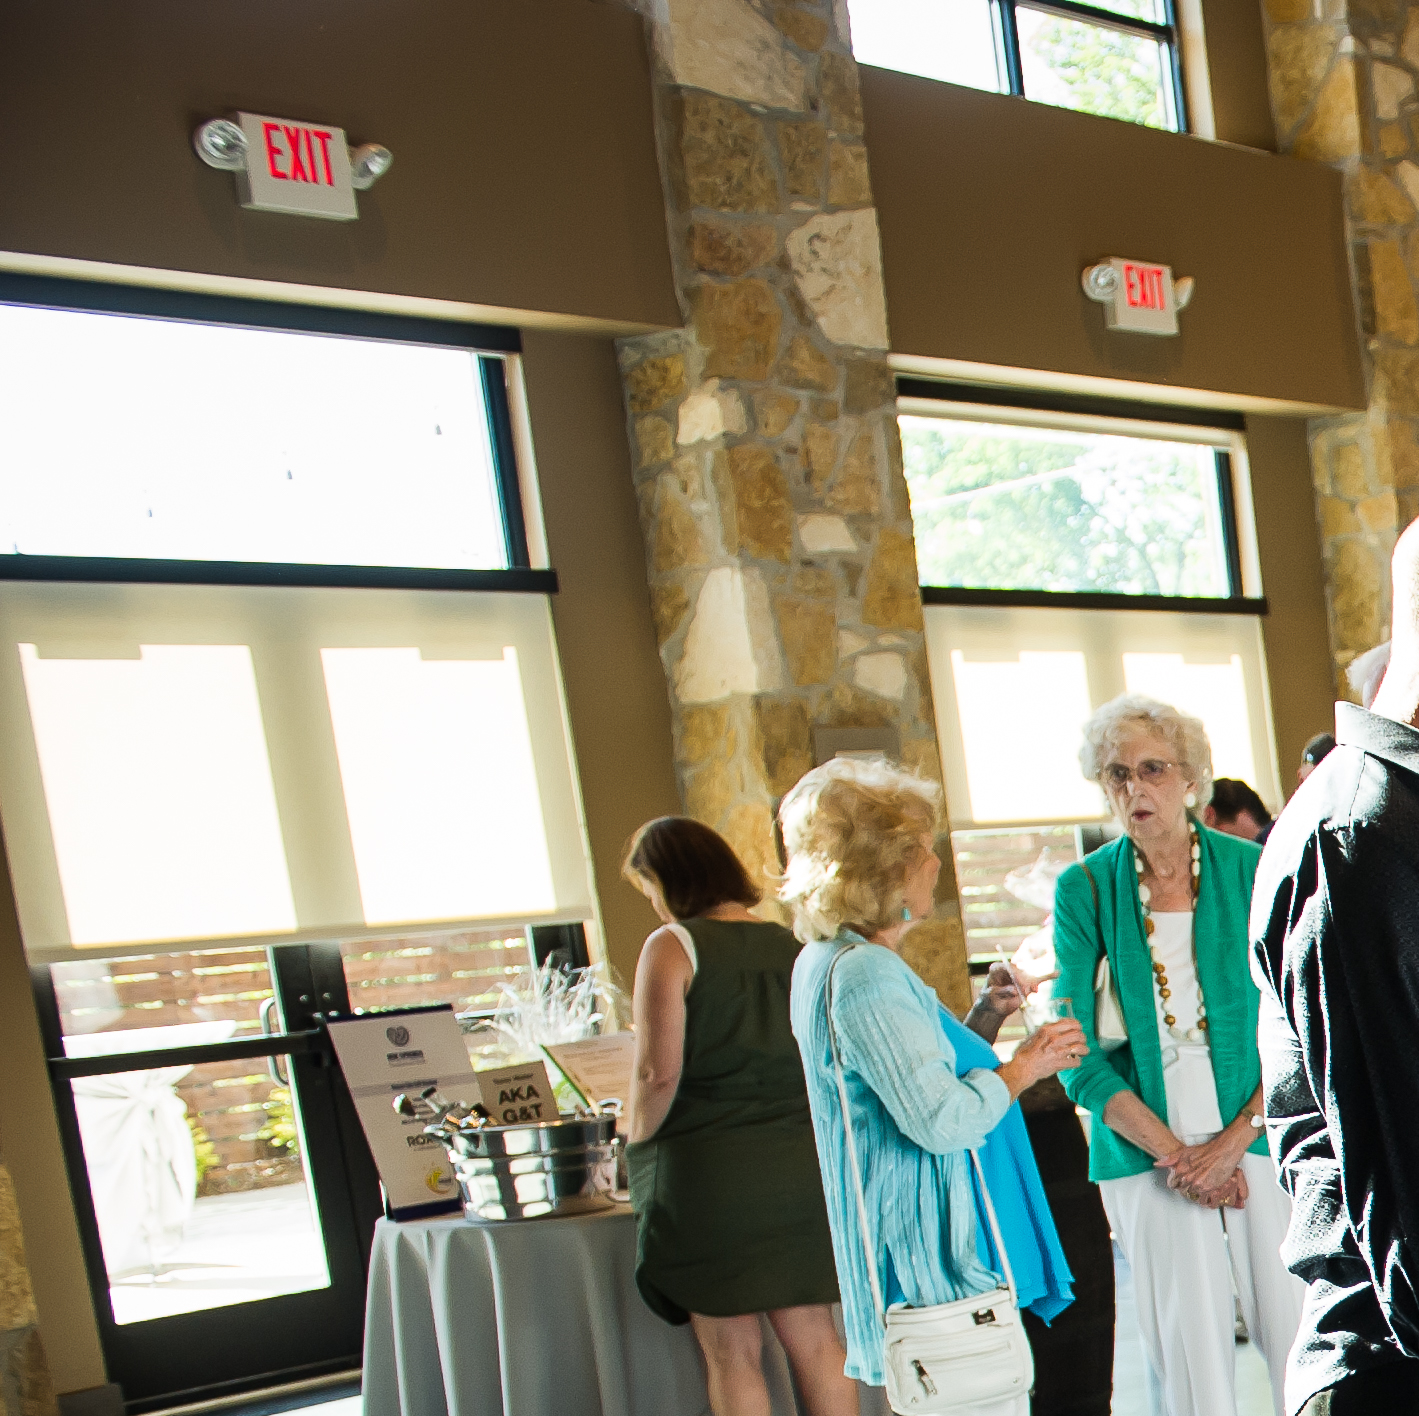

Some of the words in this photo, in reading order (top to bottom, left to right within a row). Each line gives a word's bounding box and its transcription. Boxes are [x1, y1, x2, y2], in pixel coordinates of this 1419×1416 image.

[262, 121, 335, 187] EXIT
[1123, 263, 1166, 311] EXIT
[499, 1084, 540, 1105] AKA
[502, 1103, 542, 1123] G&T
